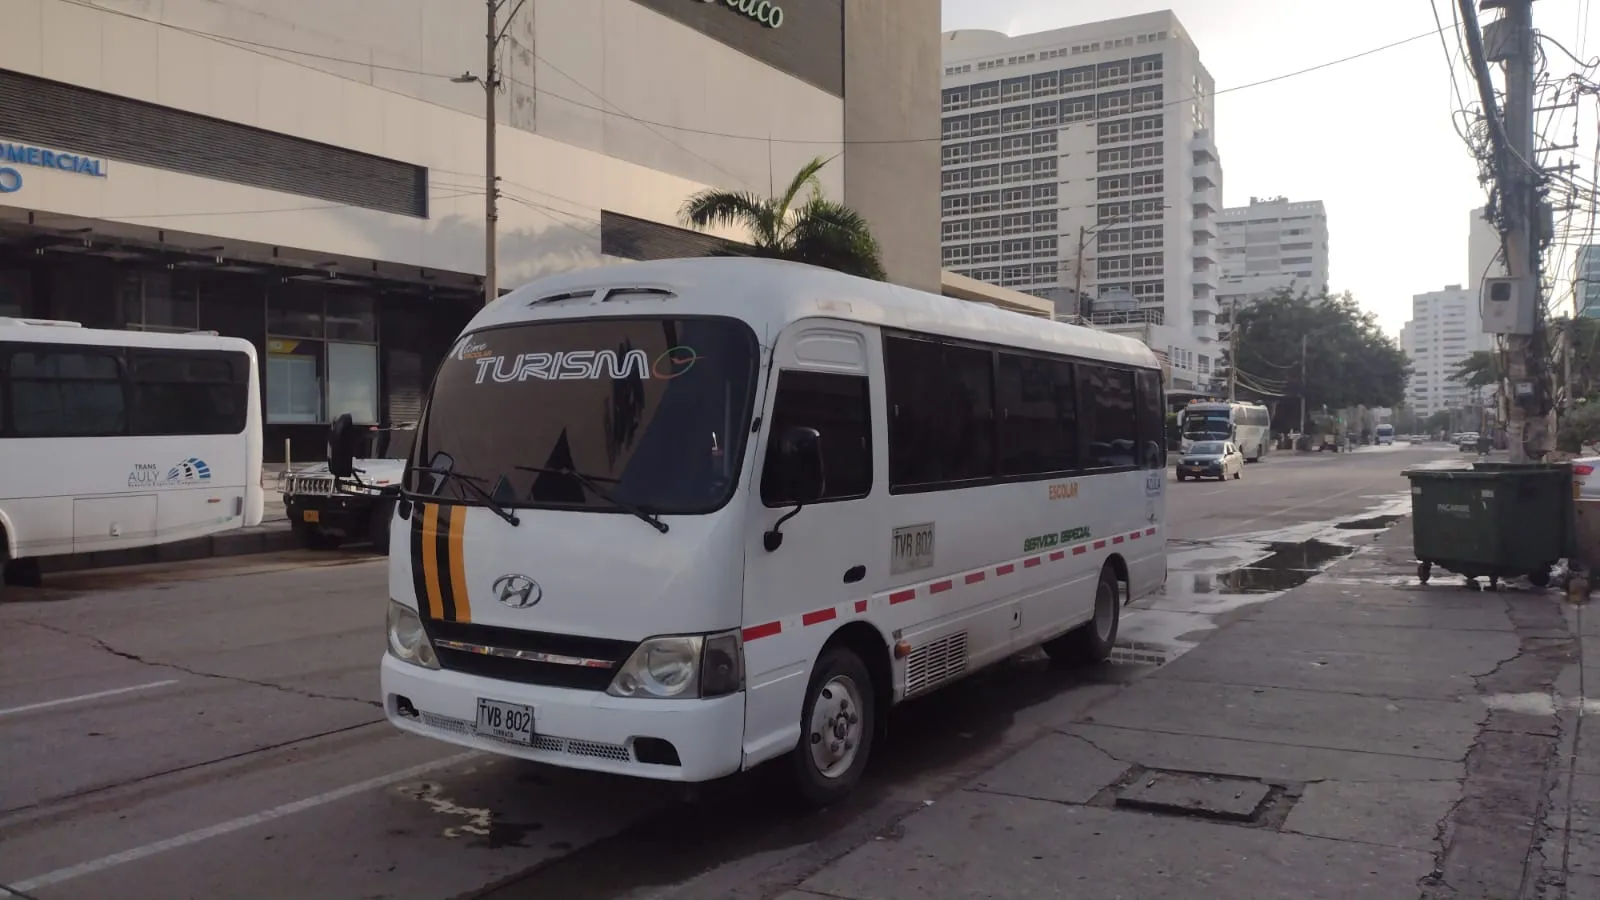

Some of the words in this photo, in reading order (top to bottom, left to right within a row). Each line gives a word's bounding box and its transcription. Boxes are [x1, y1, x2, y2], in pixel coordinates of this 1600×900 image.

[0, 143, 107, 177] MERCIAL
[128, 471, 160, 482] AULY
[1048, 482, 1078, 500] ESCOLAR
[1023, 532, 1058, 552] SERVICIO
[1060, 525, 1092, 544] ESPECIAL
[479, 704, 502, 727] TVB
[505, 710, 531, 733] 802
